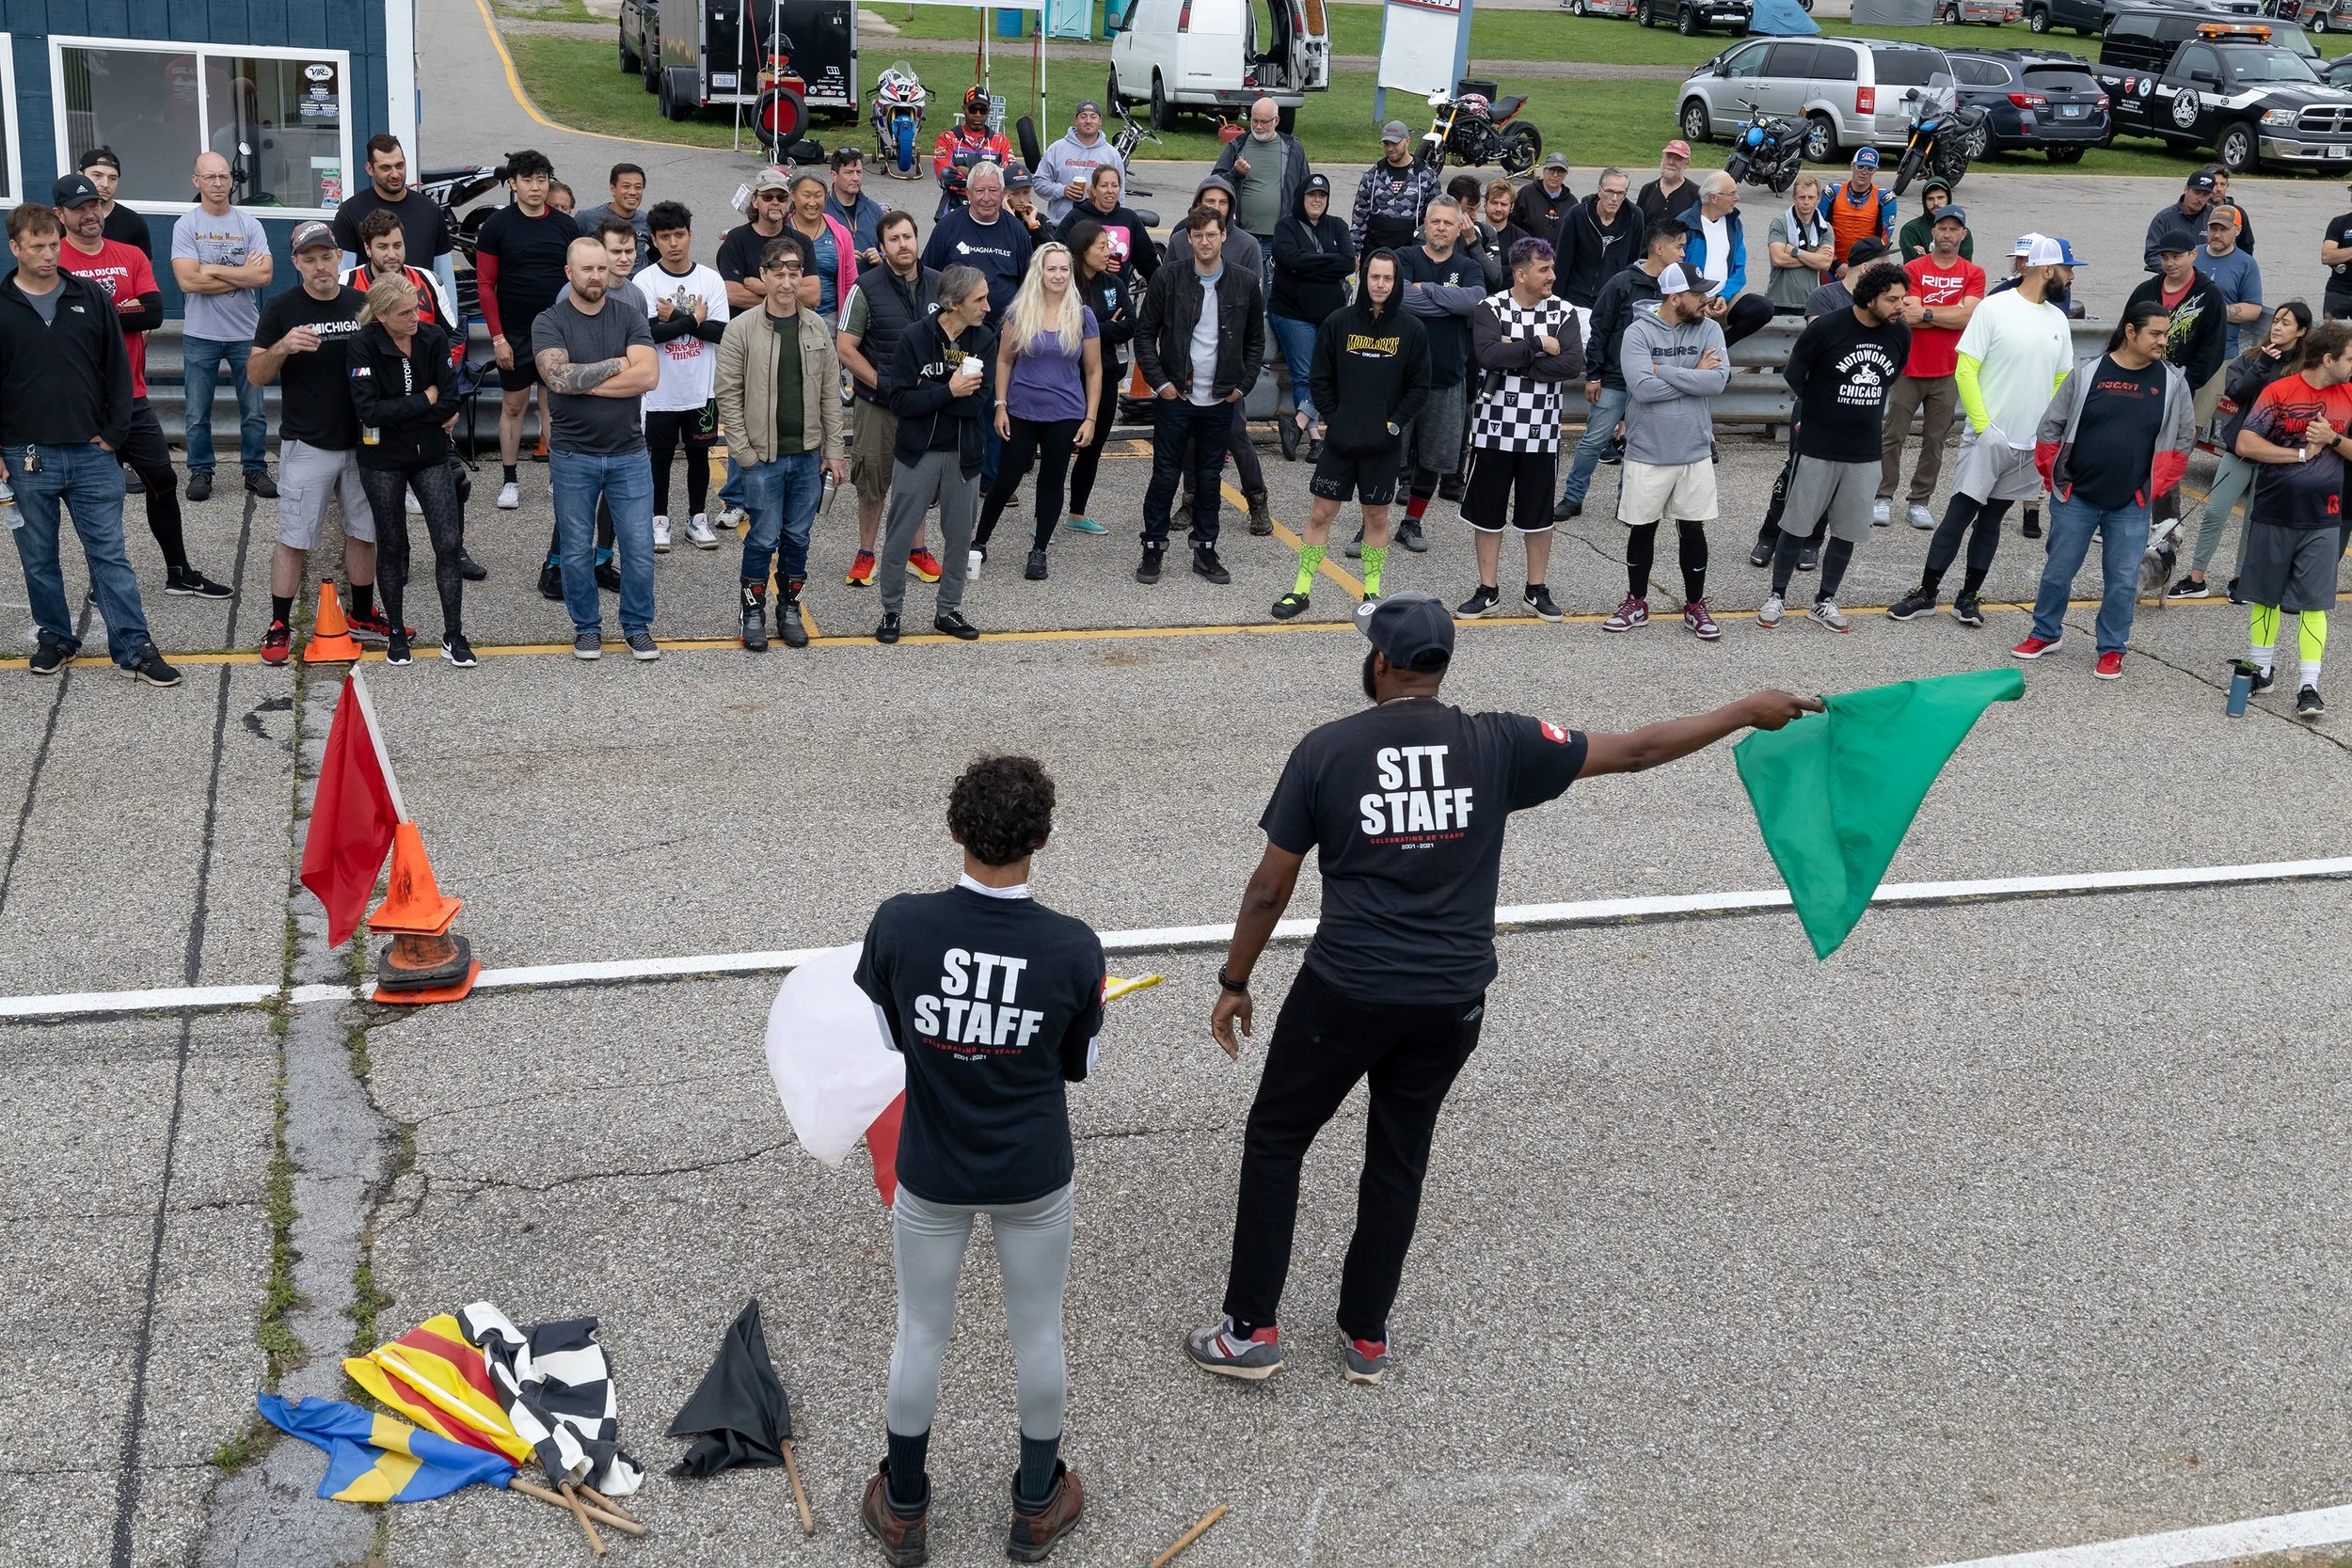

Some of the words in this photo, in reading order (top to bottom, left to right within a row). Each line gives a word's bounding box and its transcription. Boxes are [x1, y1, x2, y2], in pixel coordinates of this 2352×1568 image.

[297, 223, 328, 242] DUCATI
[1921, 274, 1964, 288] RIDE
[672, 349, 701, 361] THINGS
[1836, 349, 1895, 376] MOTOWORKS
[1837, 396, 1851, 404] LIVE
[1839, 384, 1883, 398] CHICAGO
[2327, 494, 2340, 515] 13
[1376, 745, 1449, 790] STT
[1359, 787, 1473, 835] STAFF
[1370, 834, 1423, 844] CELEBRATING
[1439, 832, 1465, 841] YEARS
[941, 948, 1027, 1004] STT
[914, 994, 1044, 1047] STAFF
[922, 1037, 977, 1054] CELEBRATING
